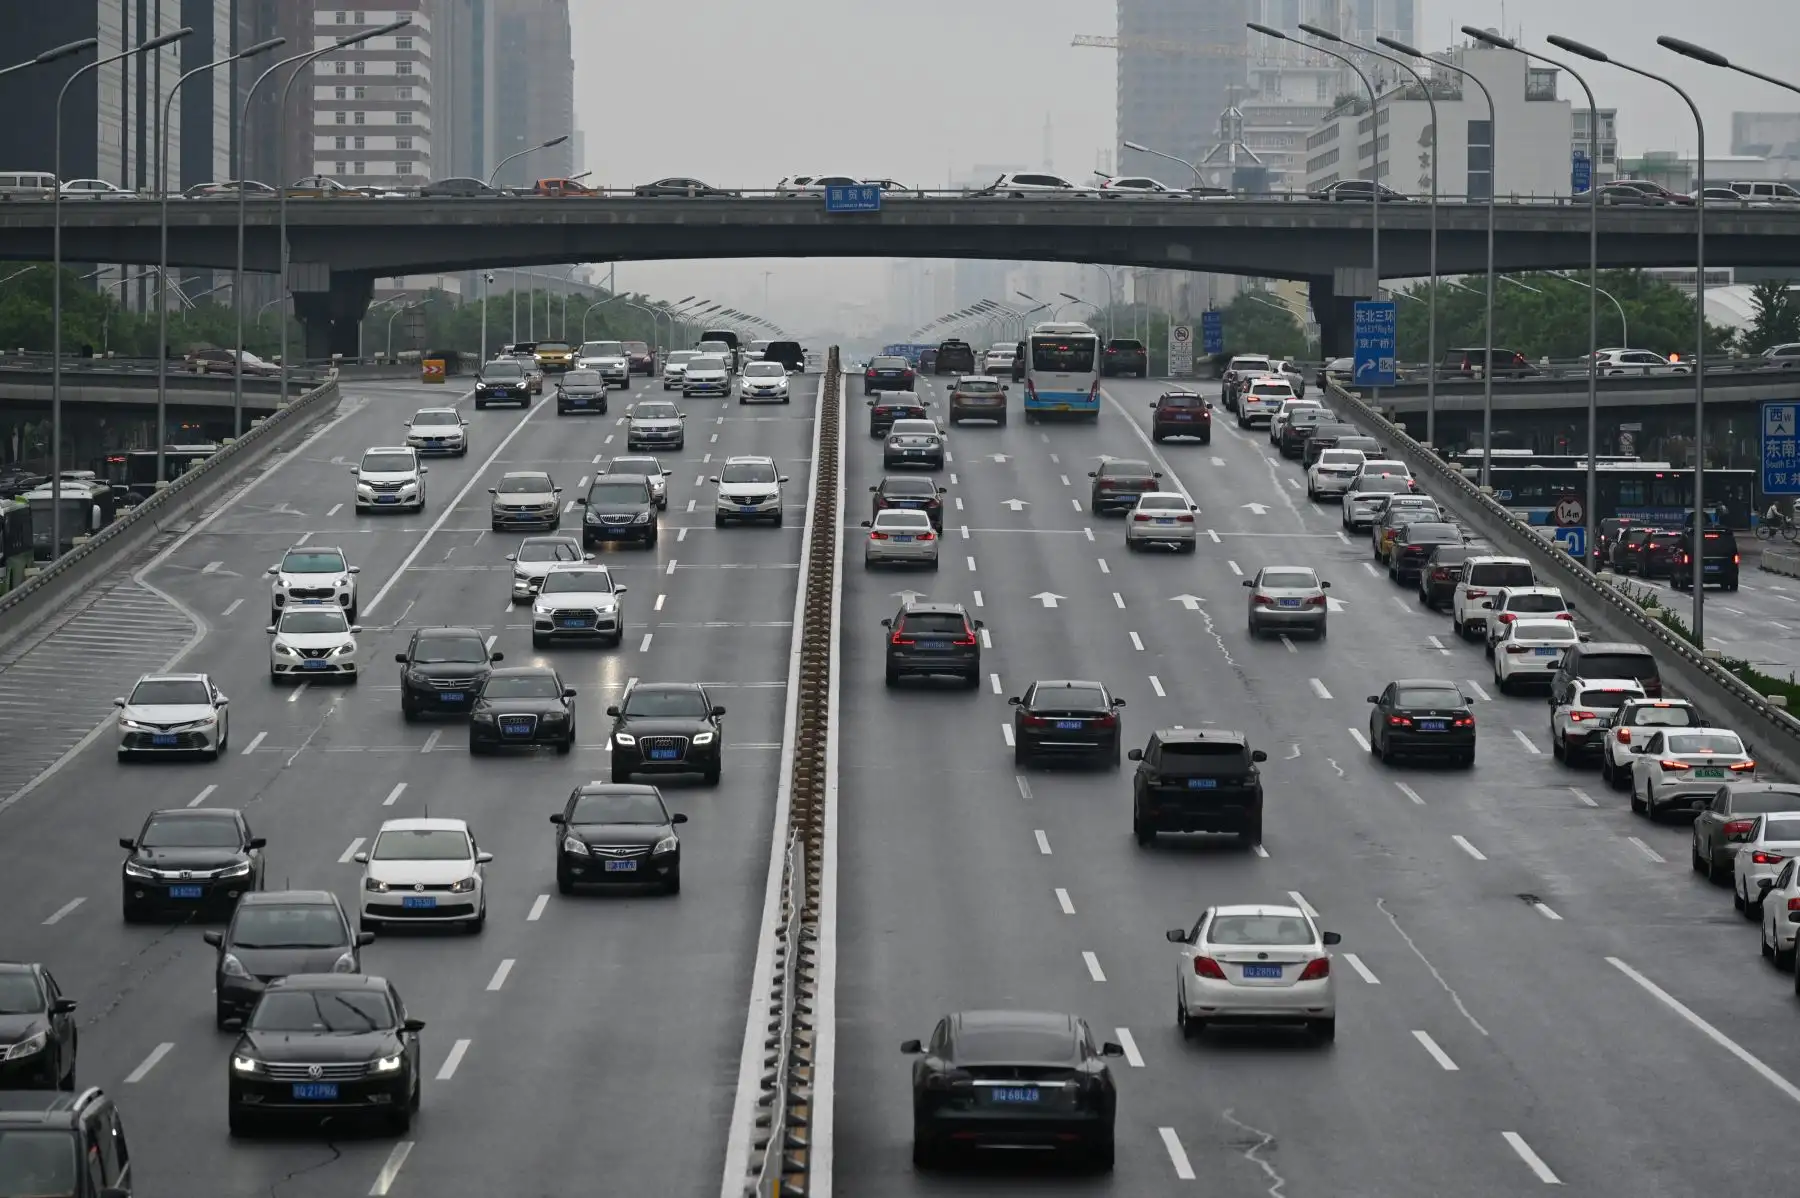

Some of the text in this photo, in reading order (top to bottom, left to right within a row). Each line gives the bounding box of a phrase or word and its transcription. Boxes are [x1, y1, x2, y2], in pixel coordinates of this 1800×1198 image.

[1356, 309, 1394, 323] 东北三环
[1766, 439, 1800, 457] 东南
